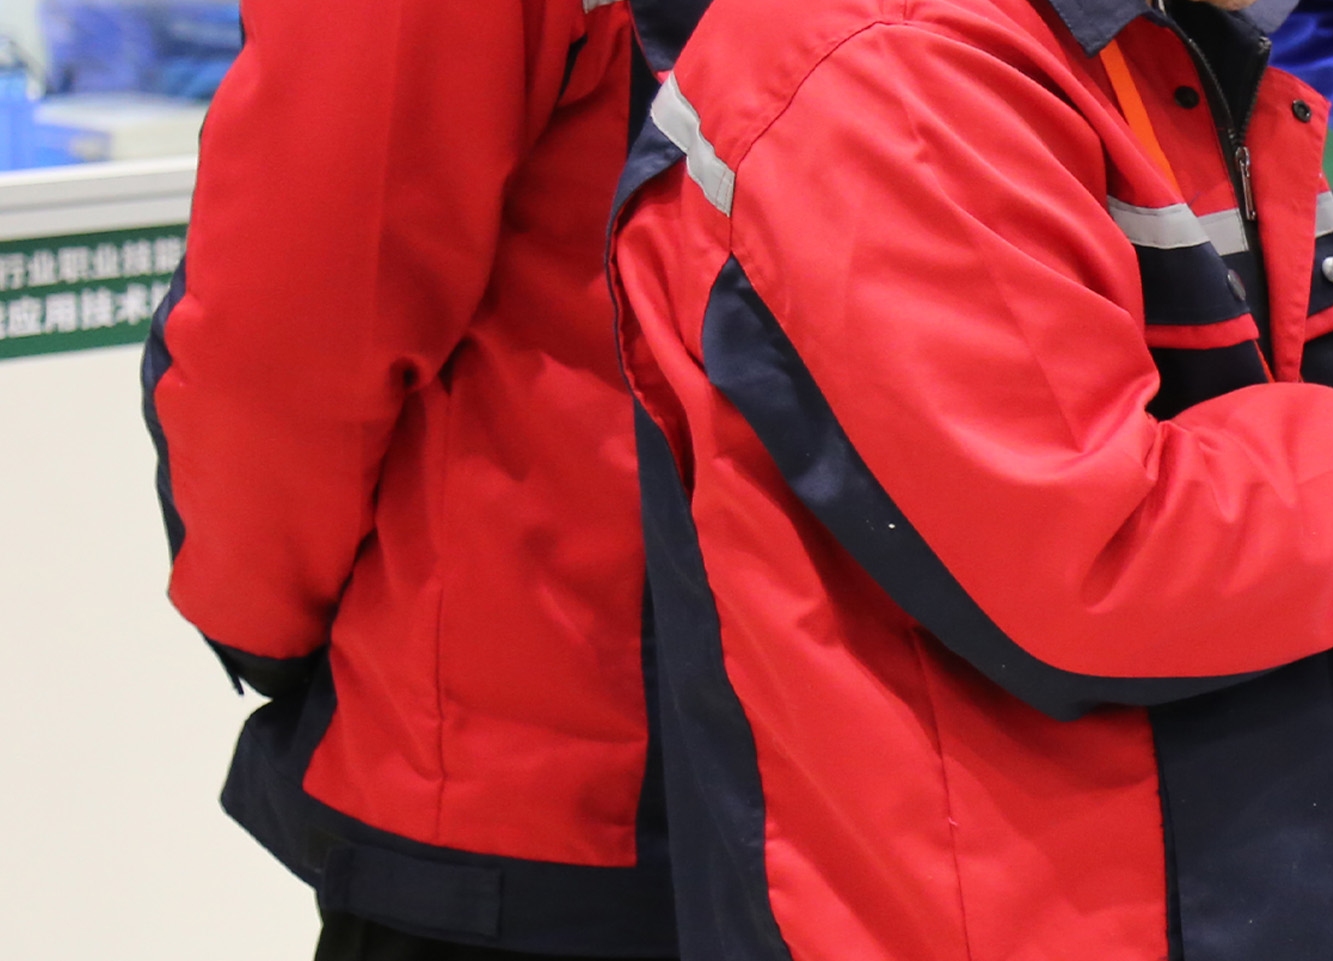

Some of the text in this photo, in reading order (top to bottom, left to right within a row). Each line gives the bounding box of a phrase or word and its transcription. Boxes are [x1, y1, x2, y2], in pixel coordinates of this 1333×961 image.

[0, 236, 186, 289] 行业职业技能
